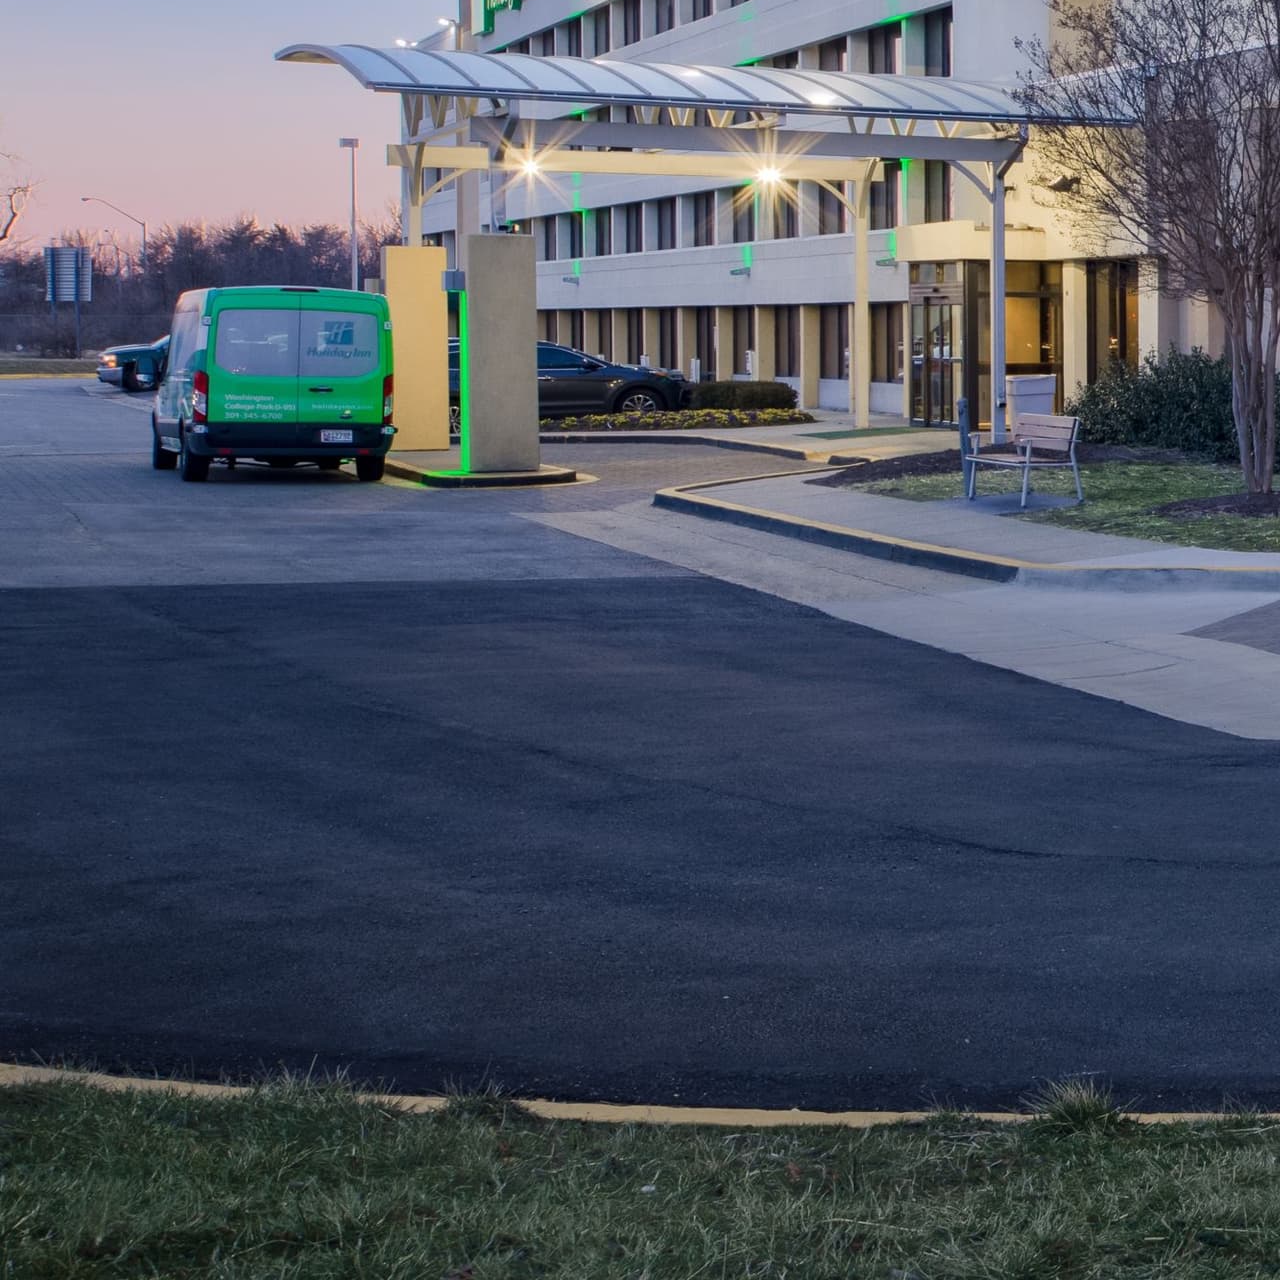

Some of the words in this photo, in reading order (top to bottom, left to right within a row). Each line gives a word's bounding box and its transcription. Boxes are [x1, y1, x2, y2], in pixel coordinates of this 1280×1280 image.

[307, 347, 352, 358] Holiday
[352, 348, 371, 357] Inn
[224, 394, 274, 402] Washington
